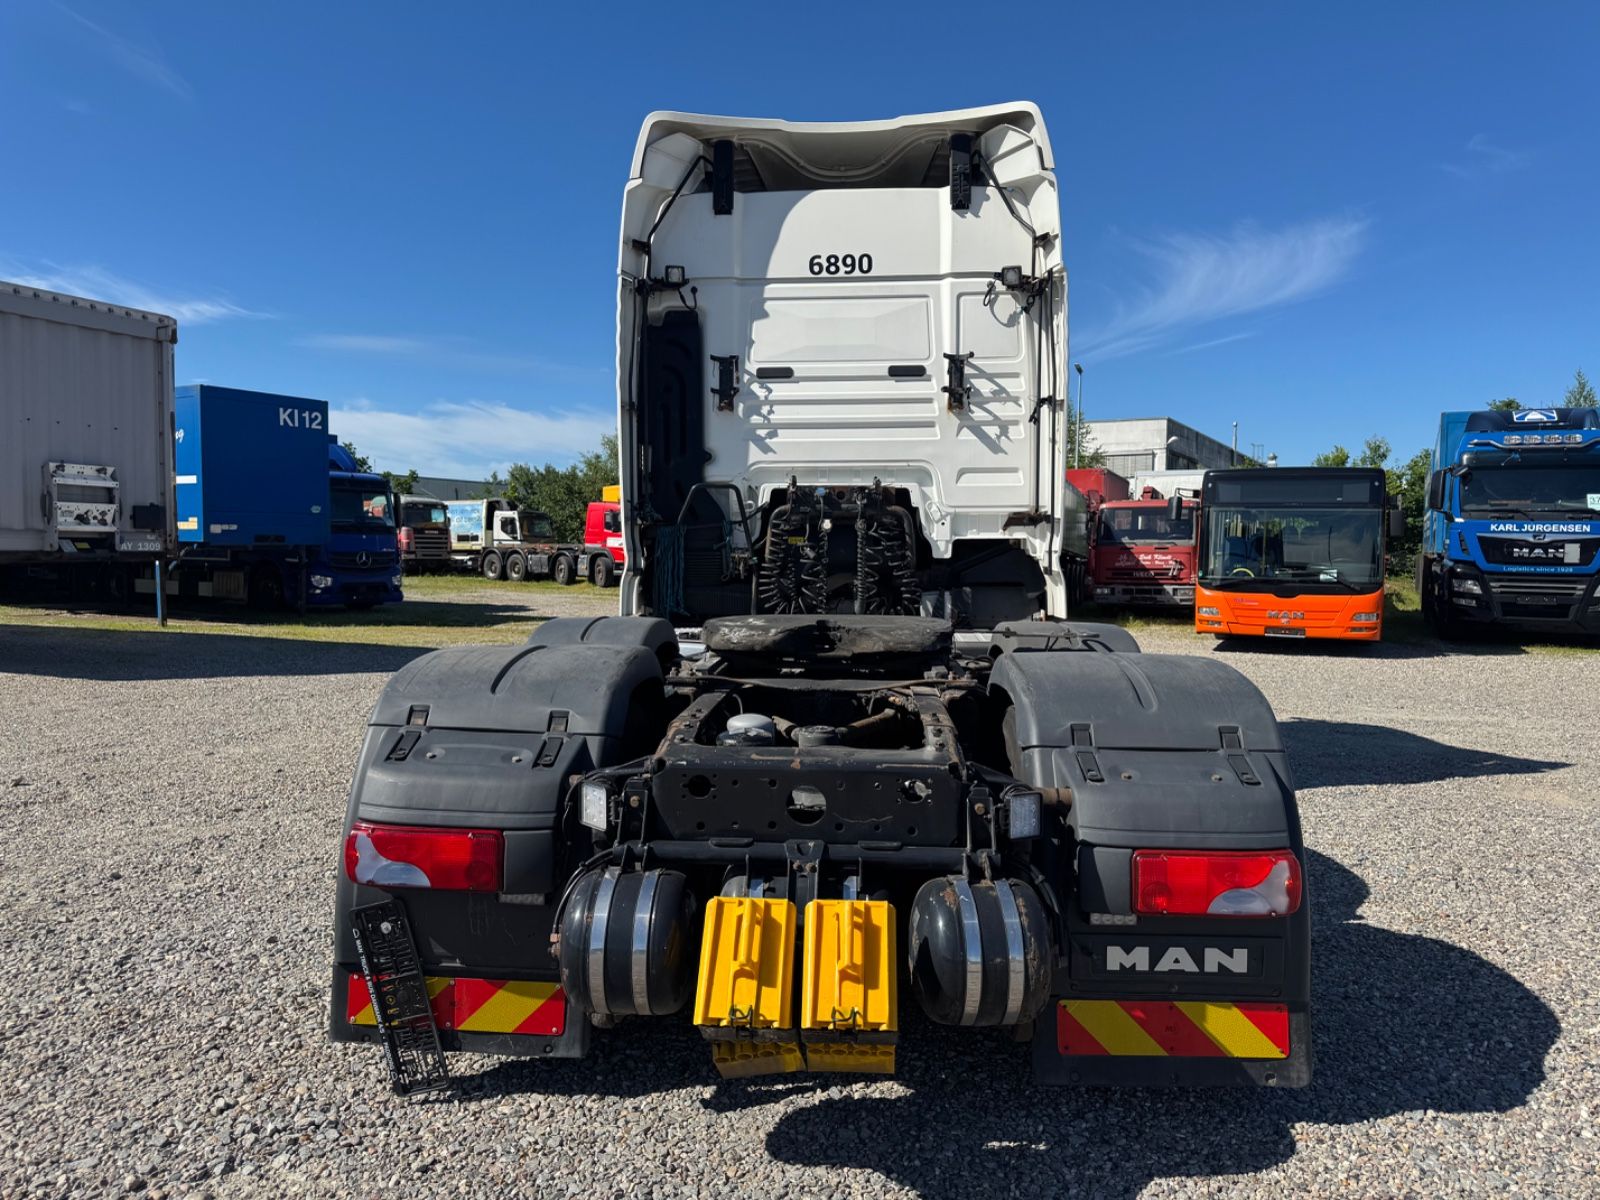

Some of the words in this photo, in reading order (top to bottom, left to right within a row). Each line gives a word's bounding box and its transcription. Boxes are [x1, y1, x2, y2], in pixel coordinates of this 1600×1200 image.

[808, 253, 873, 275] 6890
[279, 407, 299, 428] KI
[302, 411, 322, 430] 12
[1490, 523, 1520, 533] KARL
[1513, 548, 1564, 558] MAN
[1267, 610, 1305, 620] MAN
[1106, 946, 1248, 973] MAN
